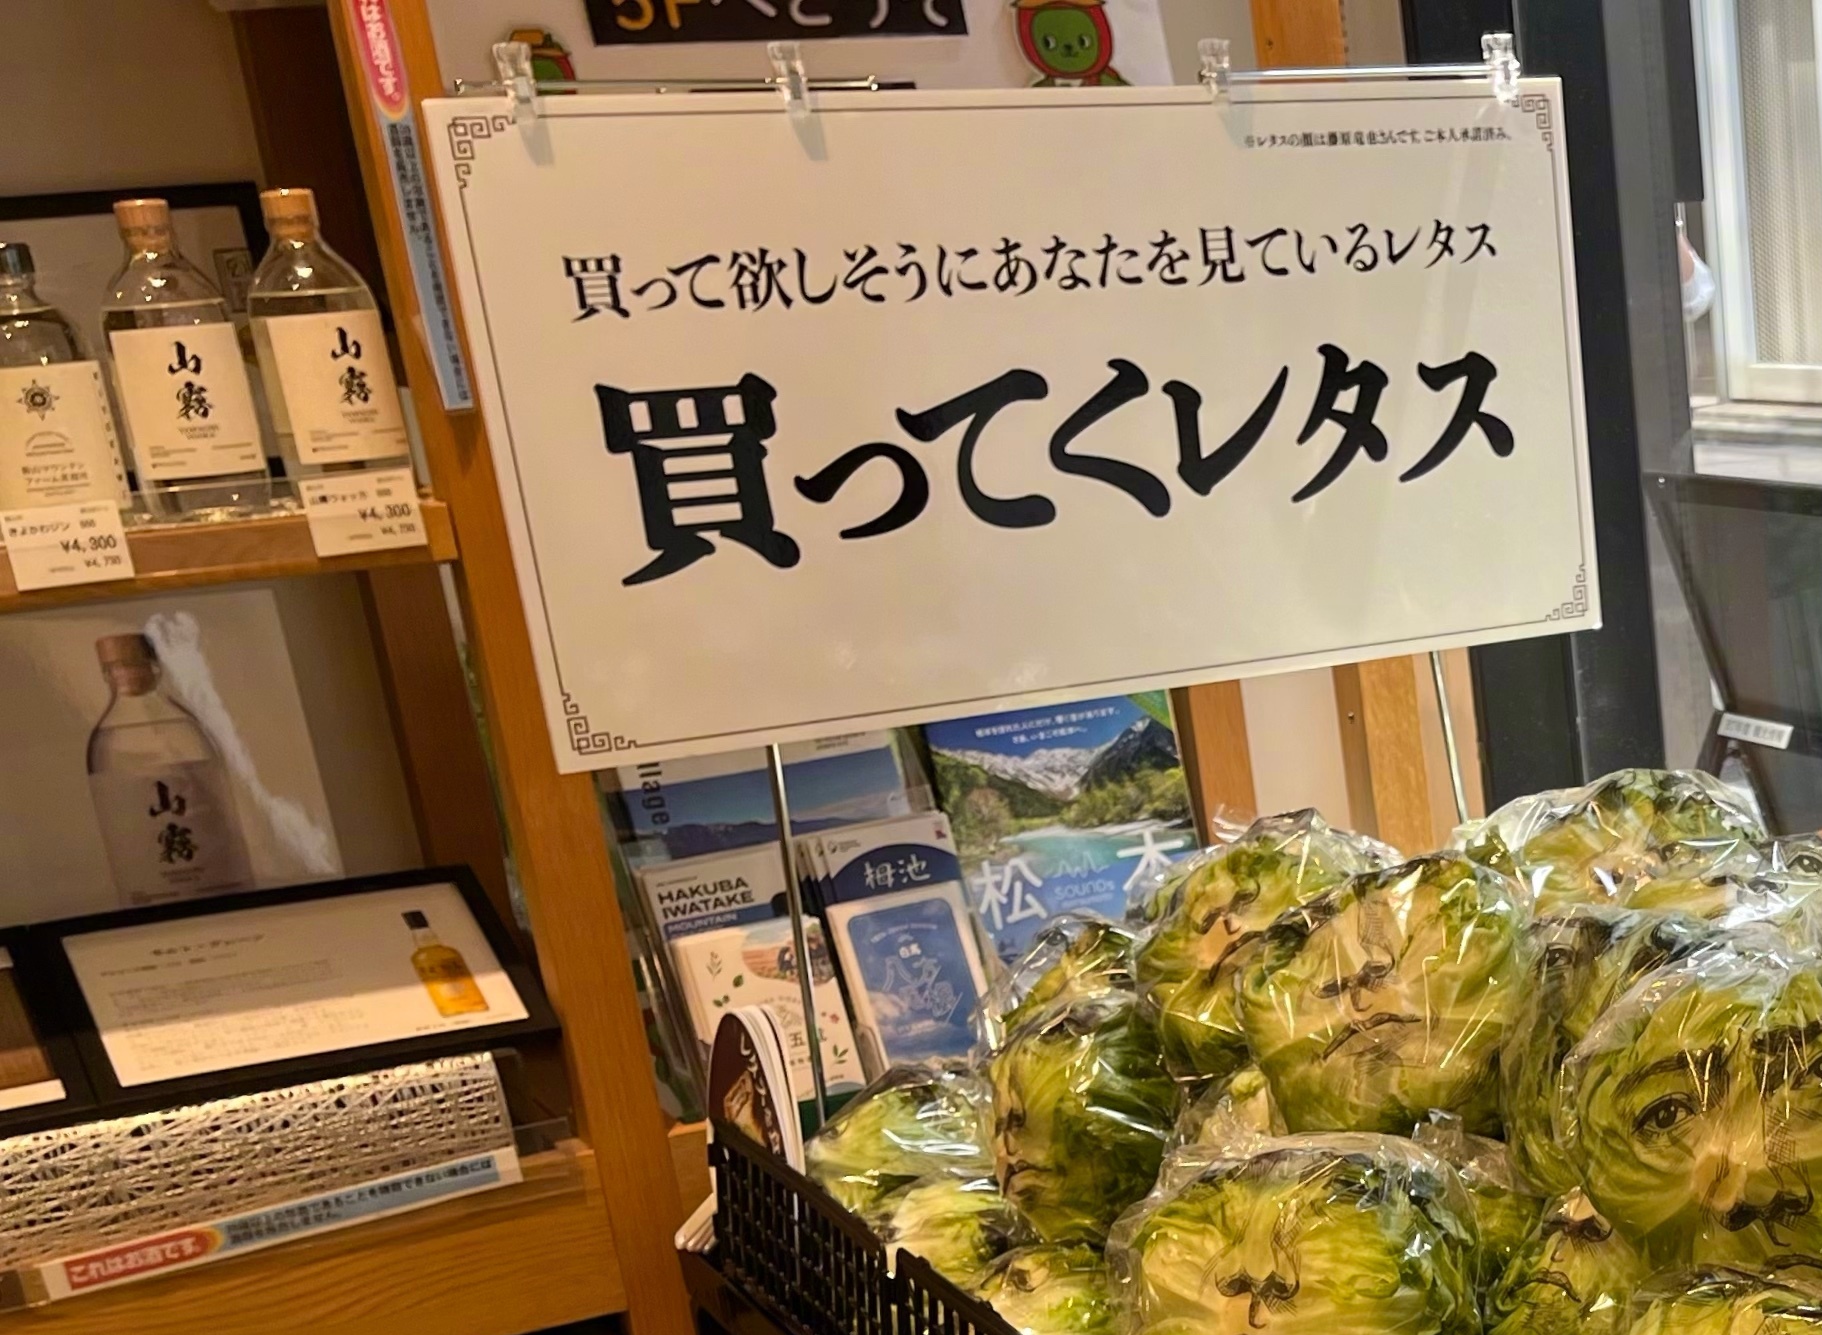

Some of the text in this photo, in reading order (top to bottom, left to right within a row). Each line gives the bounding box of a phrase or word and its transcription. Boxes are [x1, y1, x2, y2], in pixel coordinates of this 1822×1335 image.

[562, 218, 1497, 323] 買って欲しそうにあなたを見ているレタス
[593, 343, 1515, 587] 買ってくレタス
[658, 877, 748, 904] HAKUBA
[662, 891, 755, 919] IWATAKE
[668, 912, 738, 934] MOUNTAIN
